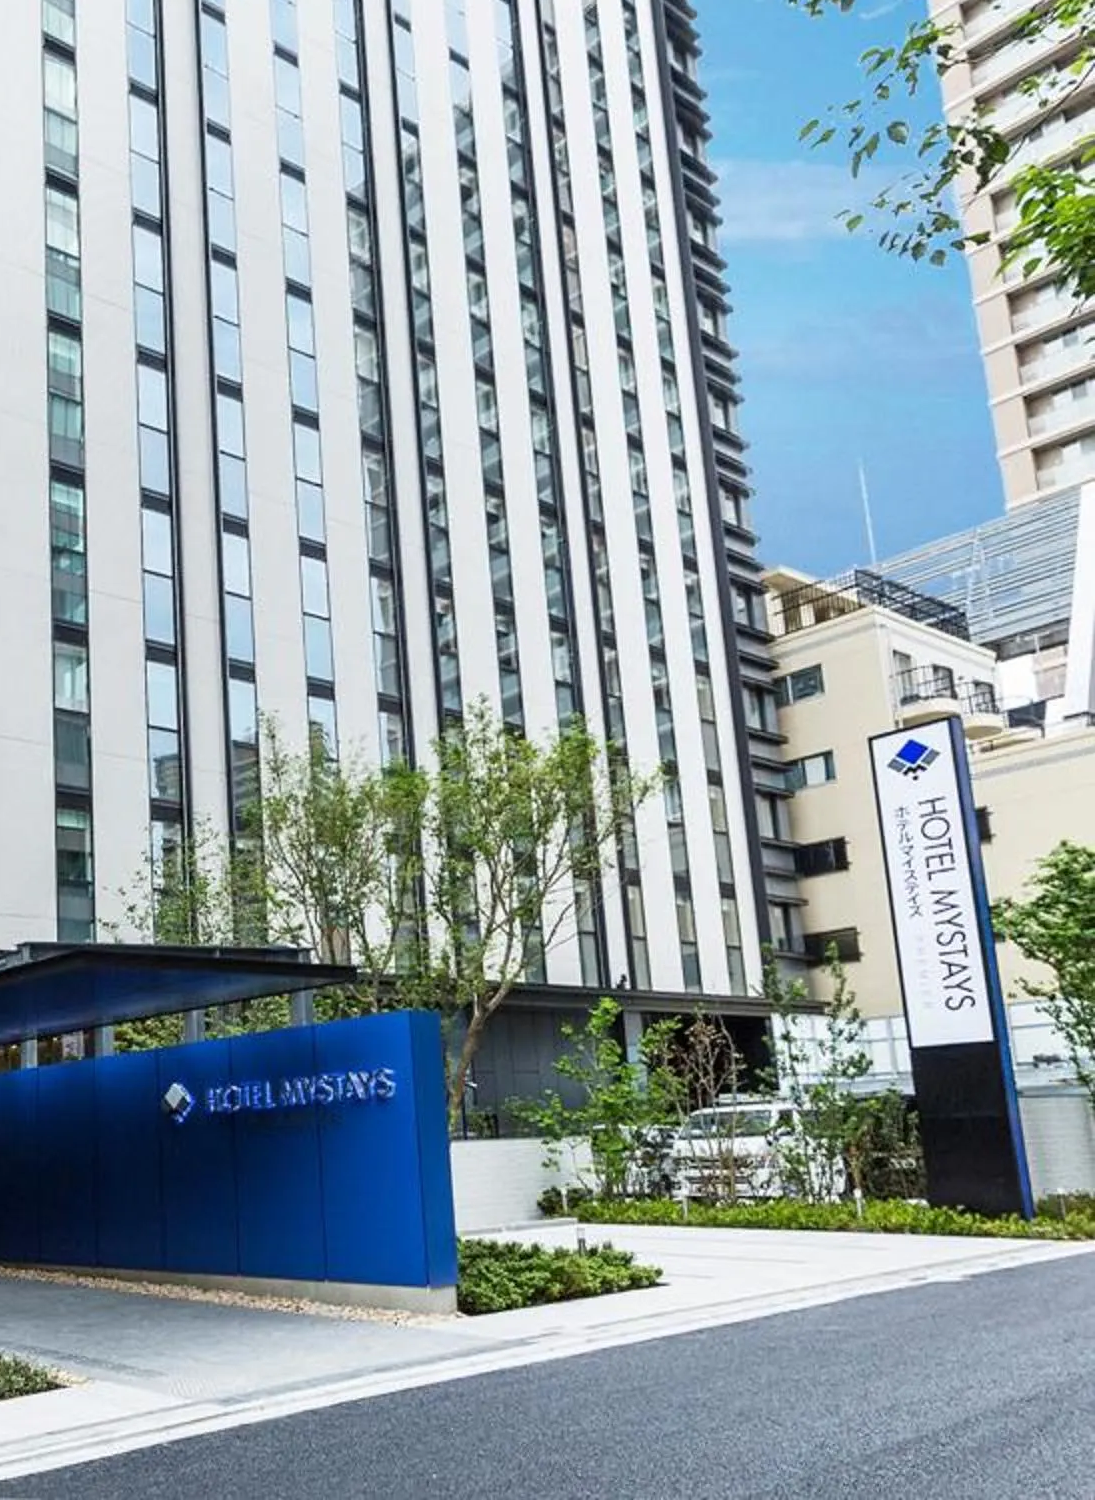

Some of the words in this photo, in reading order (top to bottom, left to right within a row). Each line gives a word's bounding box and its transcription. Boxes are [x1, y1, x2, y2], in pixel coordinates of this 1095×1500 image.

[918, 796, 956, 880] HOTEL
[930, 889, 976, 1012] MYSTAYS
[207, 1082, 276, 1112] HOTEL
[281, 1067, 397, 1106] MYSTAYS
